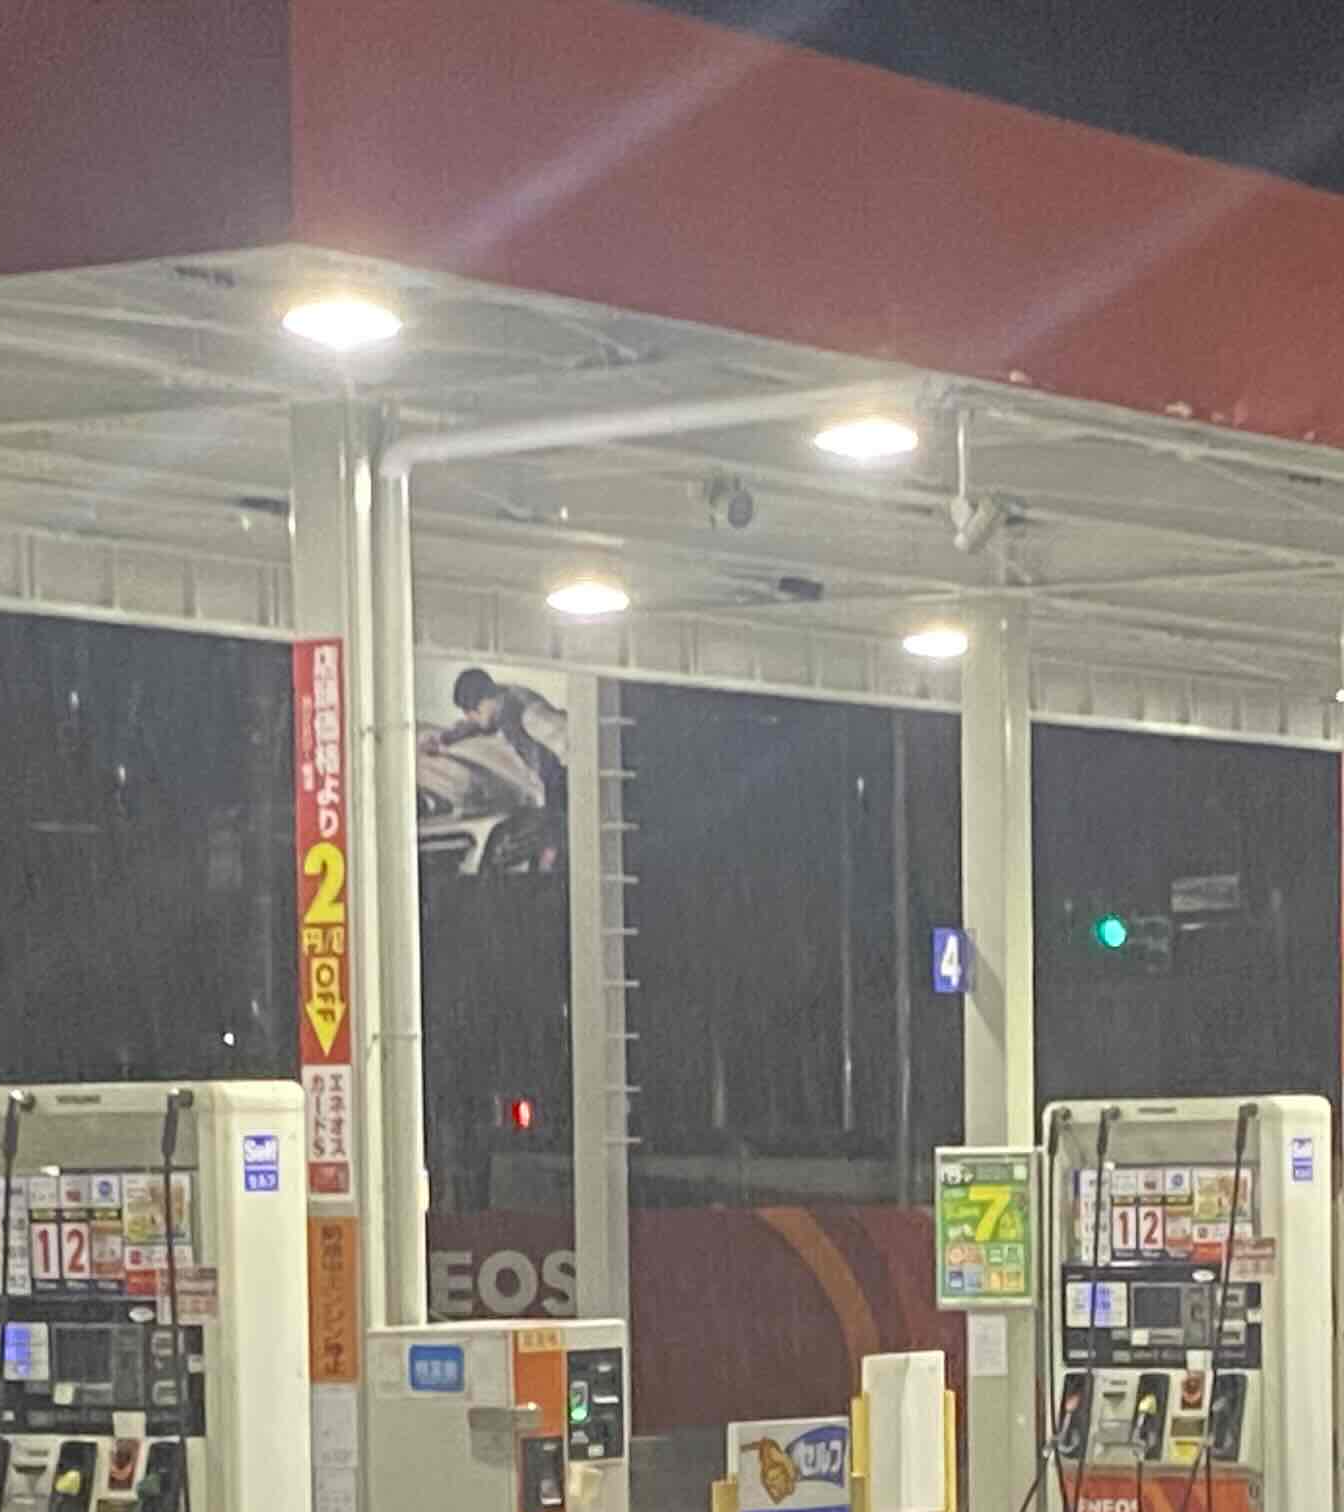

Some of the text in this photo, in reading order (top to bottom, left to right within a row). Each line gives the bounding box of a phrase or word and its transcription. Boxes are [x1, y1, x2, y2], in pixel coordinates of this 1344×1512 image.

[304, 842, 346, 923] 2
[940, 935, 961, 987] 4
[315, 962, 336, 1024] OFF
[966, 1185, 1010, 1242] 7
[798, 1438, 844, 1476] セルフ
